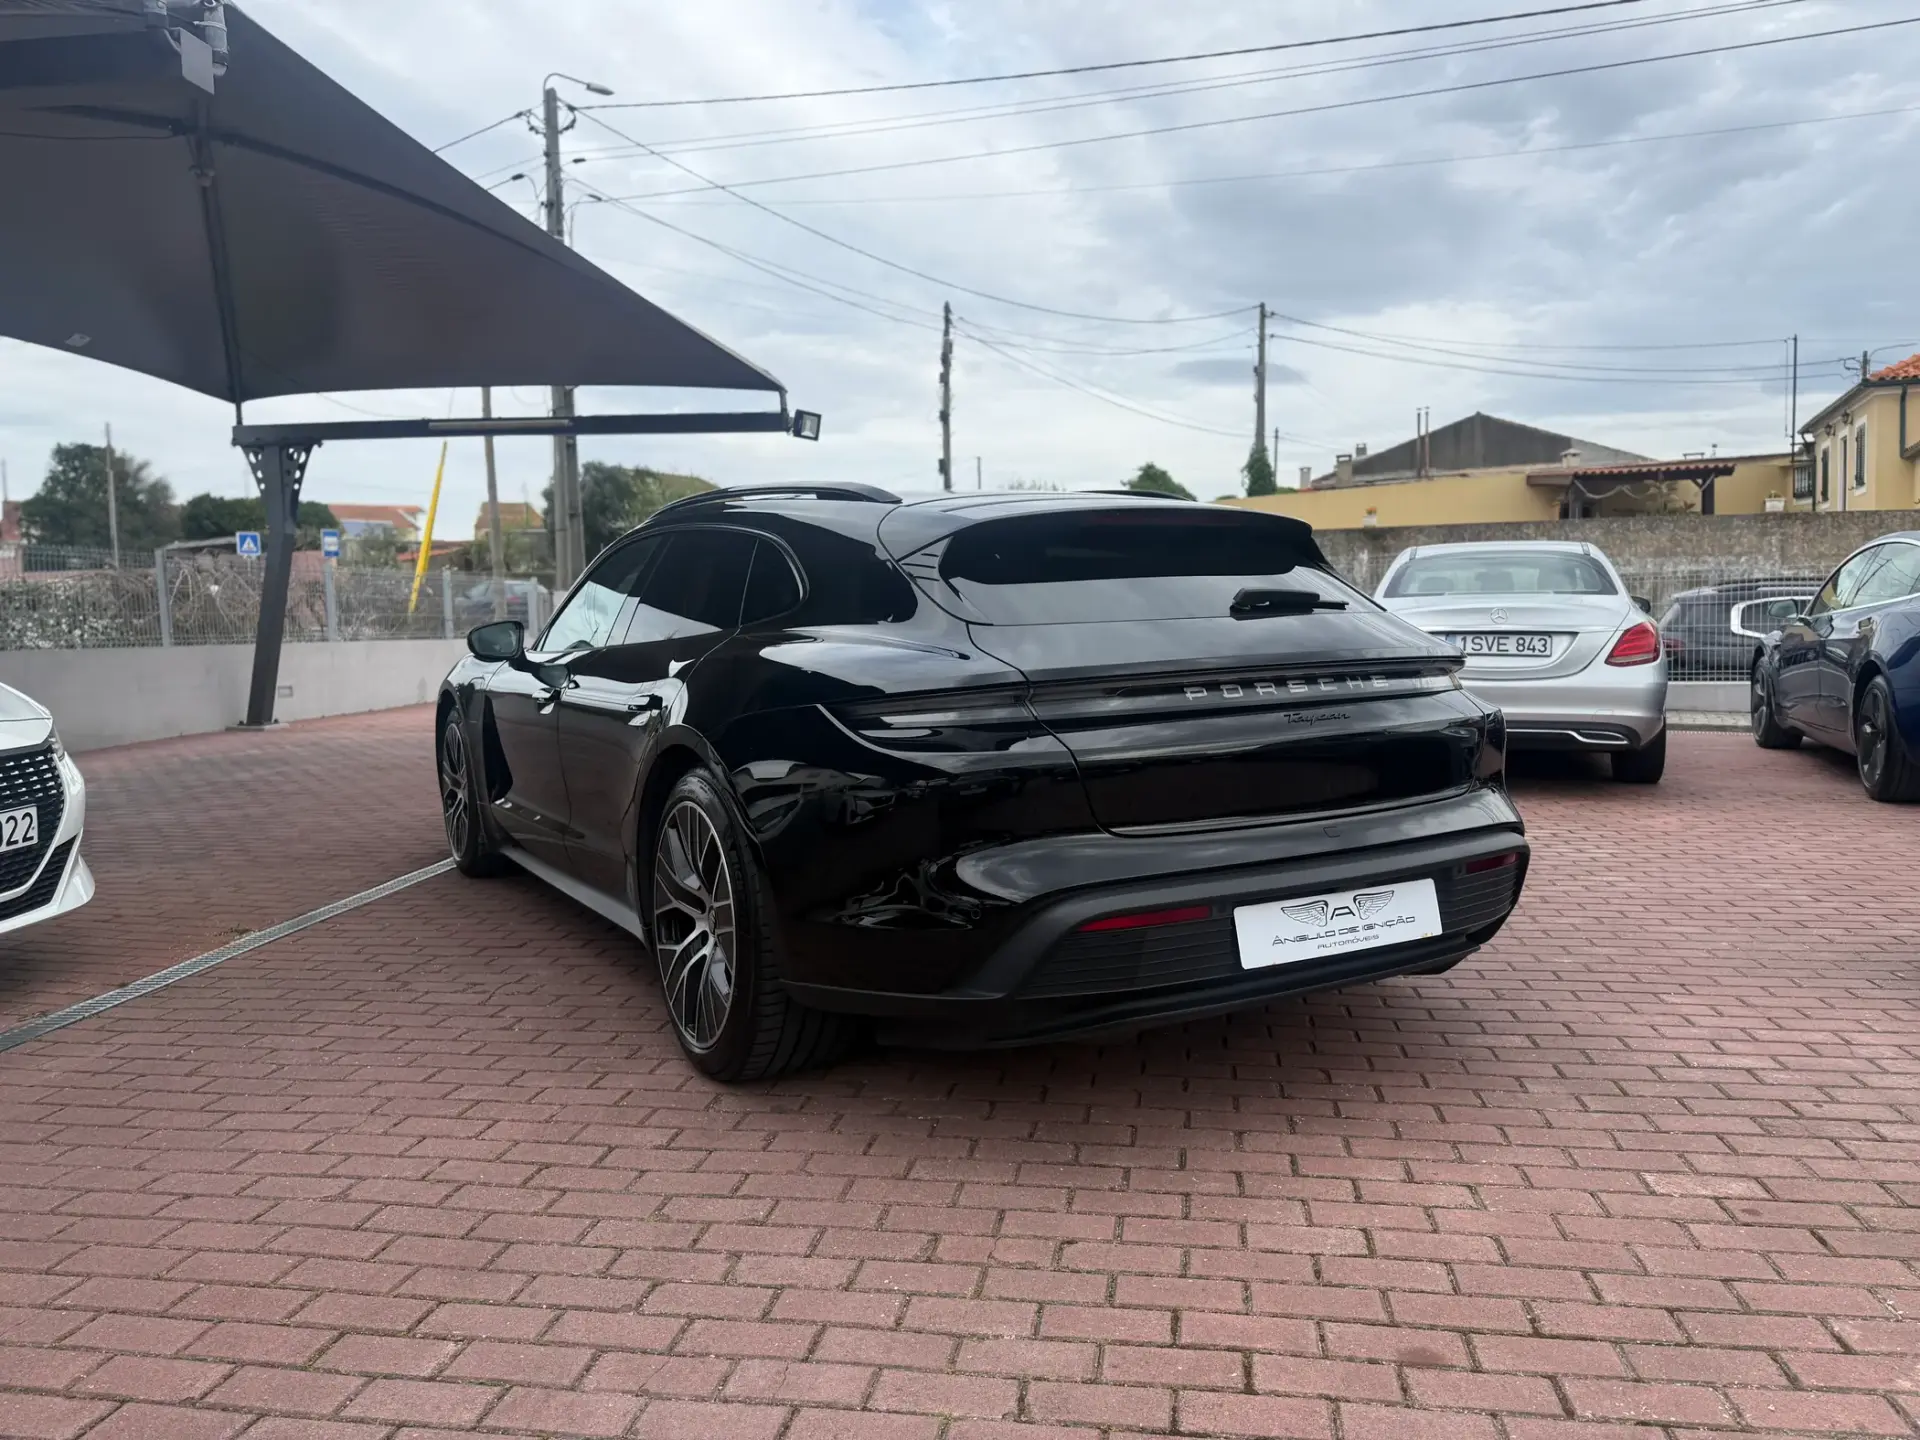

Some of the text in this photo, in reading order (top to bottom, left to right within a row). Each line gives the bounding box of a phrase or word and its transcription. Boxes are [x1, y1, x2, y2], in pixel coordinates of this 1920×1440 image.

[1515, 637, 1548, 653] 843
[1183, 674, 1389, 701] PORSCHE
[1283, 712, 1351, 726] Taycan
[0, 811, 34, 849] 22
[1271, 915, 1416, 947] ÂNGULO DE IGNIÇÃO
[1316, 933, 1380, 950] AUTOMÓVEIS
